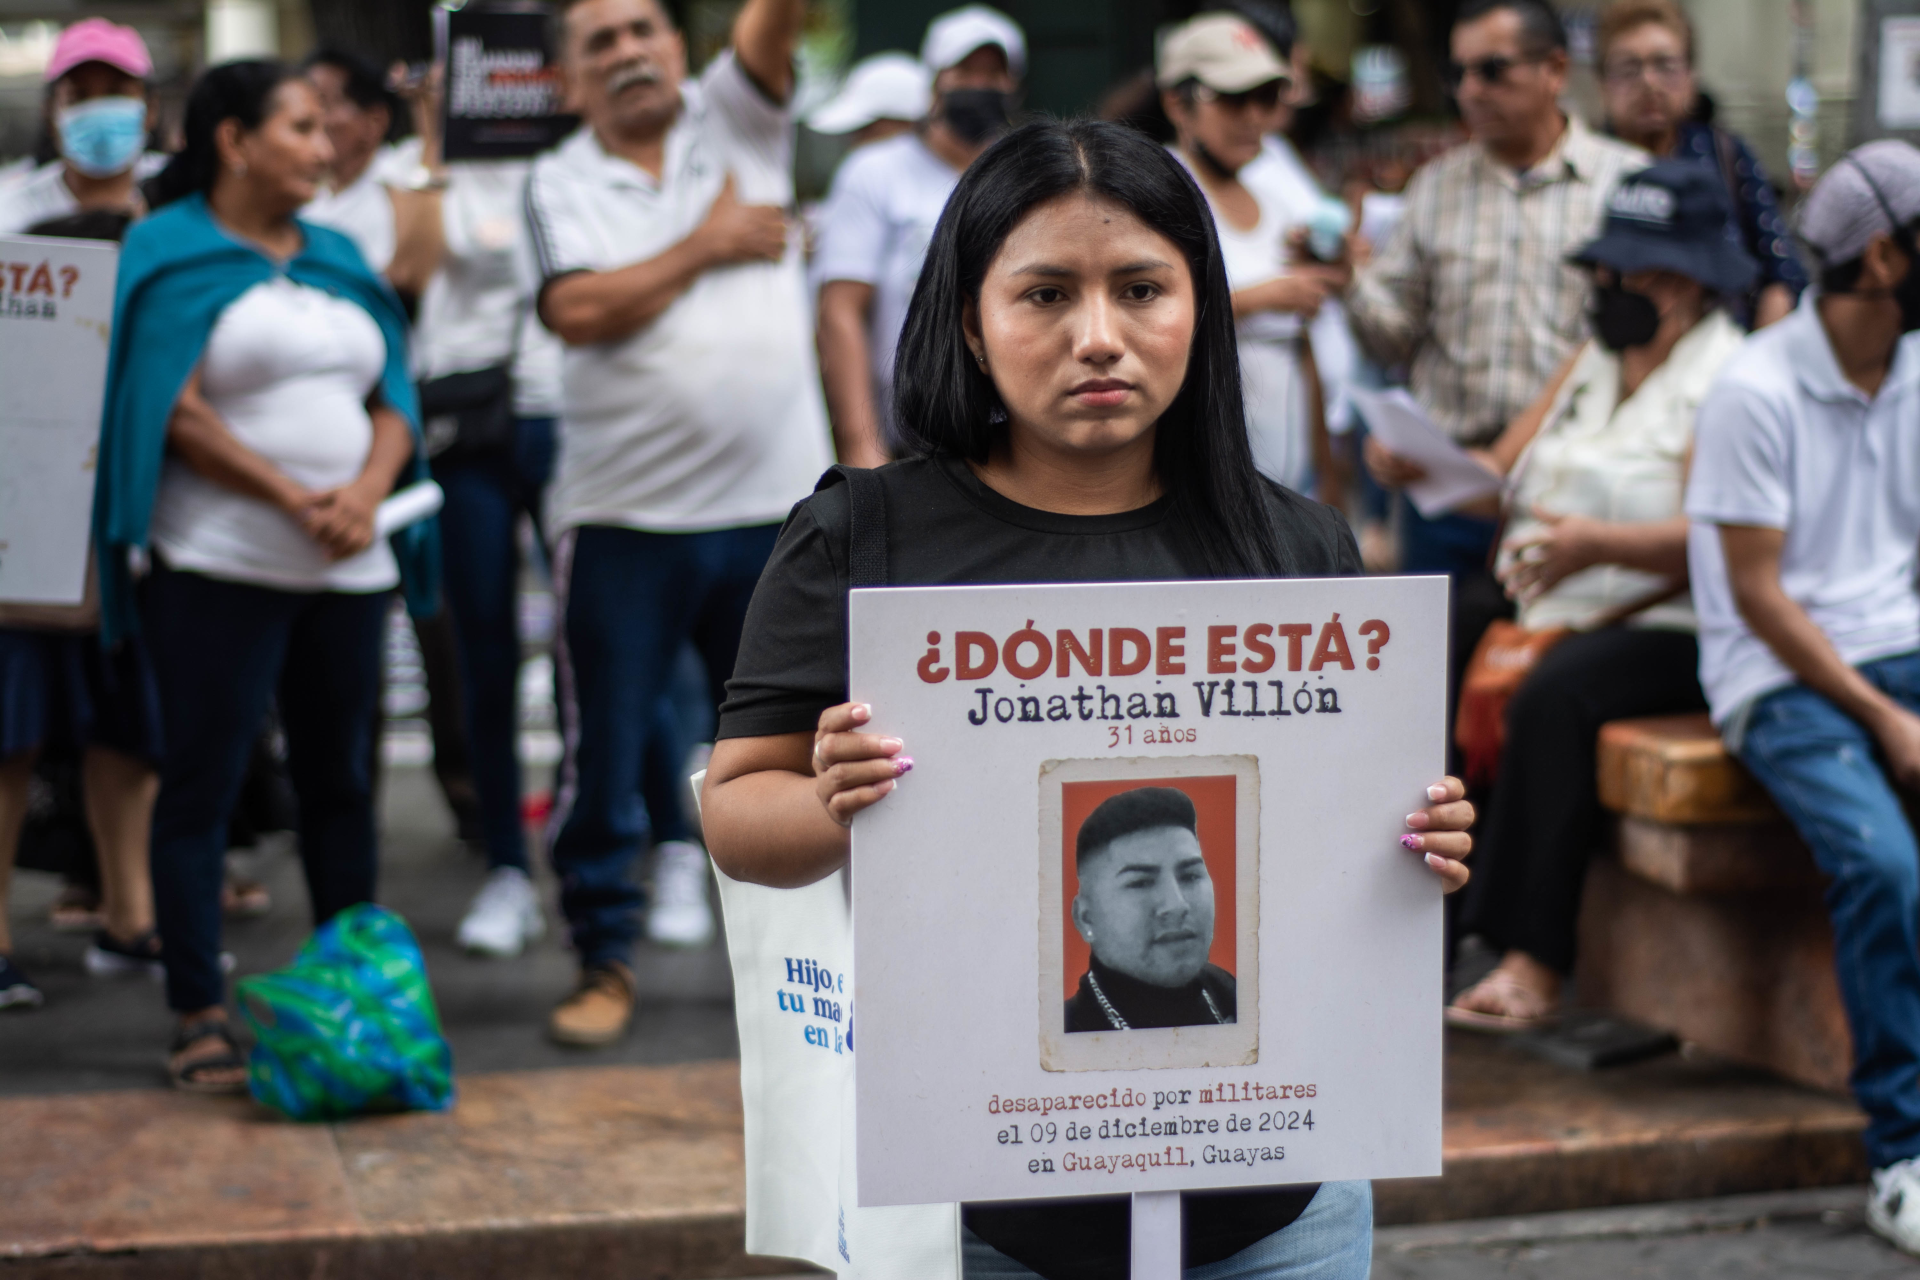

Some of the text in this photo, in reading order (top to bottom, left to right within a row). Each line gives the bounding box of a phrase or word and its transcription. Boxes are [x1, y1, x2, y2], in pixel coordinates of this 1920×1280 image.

[0, 257, 80, 300] TÁ?
[916, 612, 1391, 684] ¿DÓNDE ESTÁ?
[967, 679, 1342, 726] Jonathan Villón
[1107, 724, 1197, 748] 31 años
[784, 957, 835, 993] Hijo,
[776, 988, 843, 1023] tu ma
[803, 1024, 829, 1048] en
[988, 1081, 1318, 1116] desaparecido por militares
[996, 1109, 1316, 1145] el 09 de diciembre de 2024
[1027, 1144, 1286, 1174] en Guayaquil, Guayas
